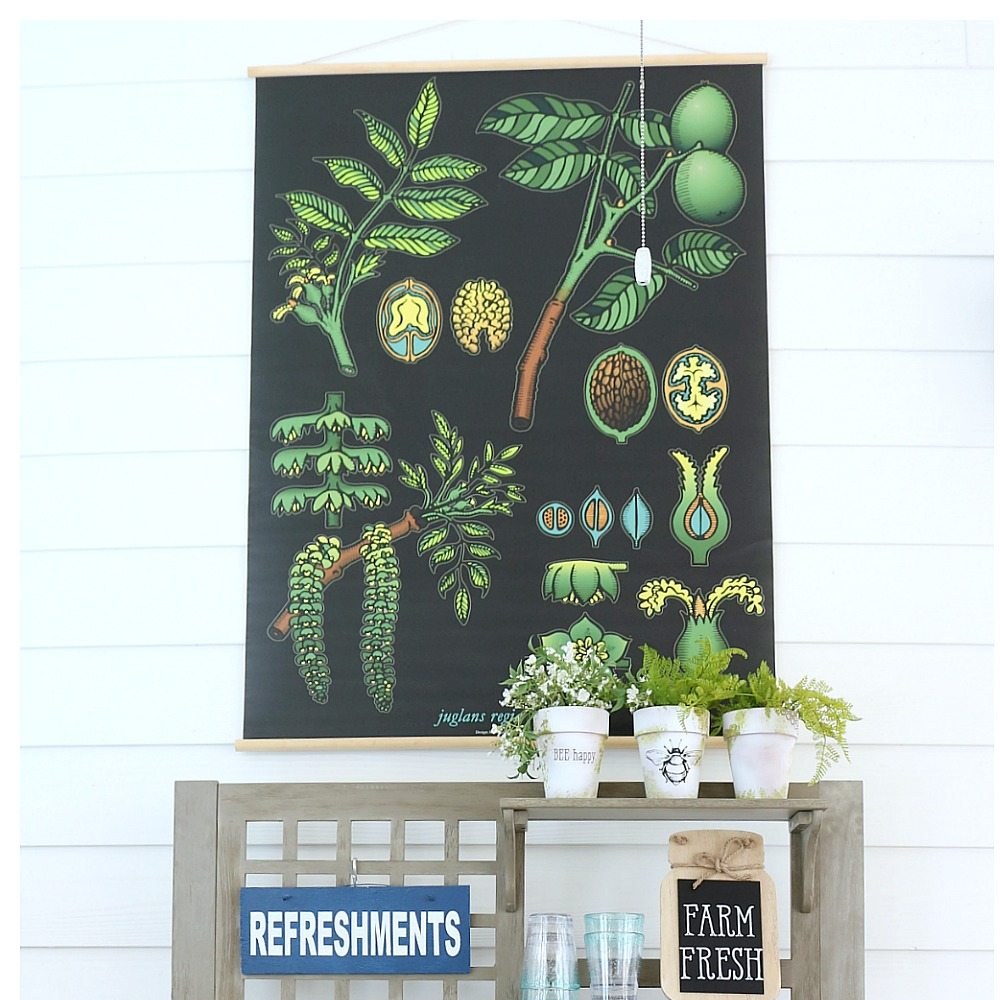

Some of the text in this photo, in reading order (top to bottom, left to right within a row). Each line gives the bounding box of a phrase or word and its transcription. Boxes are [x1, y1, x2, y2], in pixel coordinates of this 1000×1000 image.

[433, 707, 516, 727] juglans regi
[553, 748, 597, 764] BEE happy
[249, 910, 462, 957] REFRESHMENTS
[683, 903, 756, 938] FARM
[679, 946, 765, 981] FRESH
